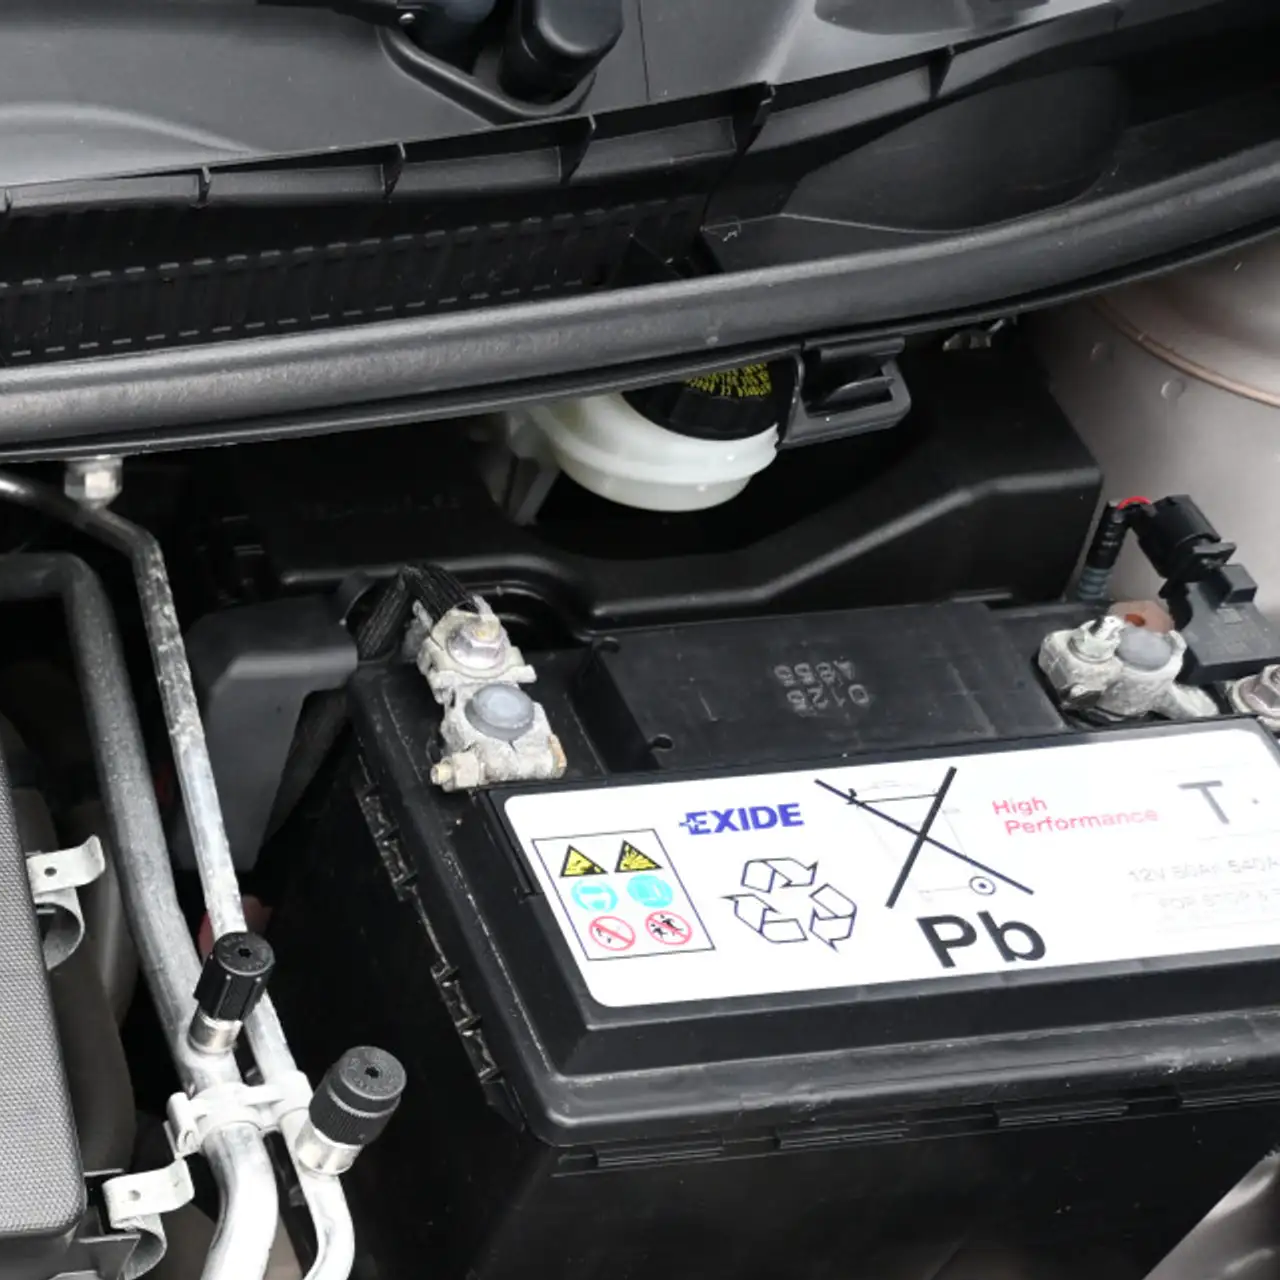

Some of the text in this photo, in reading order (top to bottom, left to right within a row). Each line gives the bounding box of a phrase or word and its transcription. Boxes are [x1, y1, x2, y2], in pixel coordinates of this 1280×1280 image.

[681, 803, 804, 836] EXIDE
[991, 796, 1048, 818] High
[1003, 808, 1160, 837] Performance
[915, 910, 1047, 969] Pb
